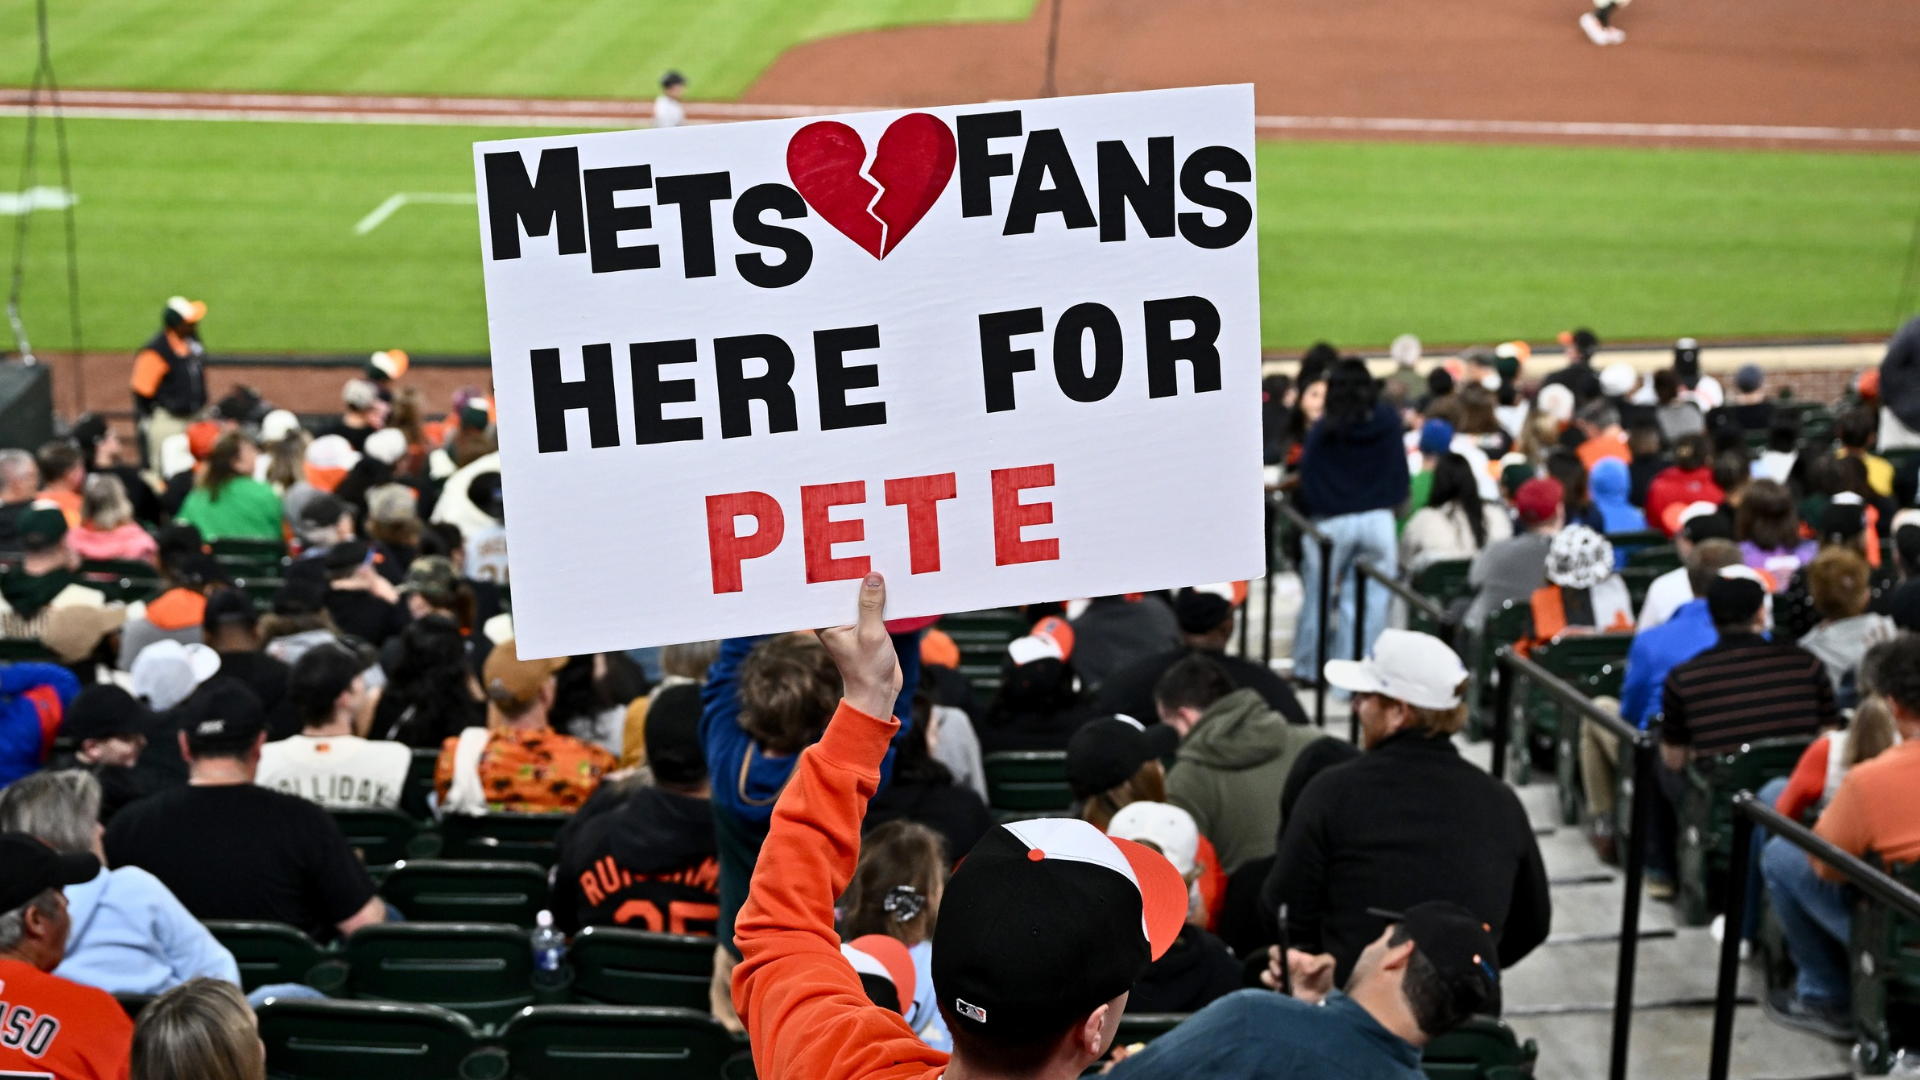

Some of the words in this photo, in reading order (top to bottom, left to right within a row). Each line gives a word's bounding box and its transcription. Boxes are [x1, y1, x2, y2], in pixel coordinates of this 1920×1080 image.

[484, 146, 814, 289] METS
[957, 110, 1253, 250] FANS
[529, 324, 887, 454] HERE
[978, 295, 1222, 414] FOR
[705, 463, 1060, 595] PETE
[0, 999, 61, 1059] SO
